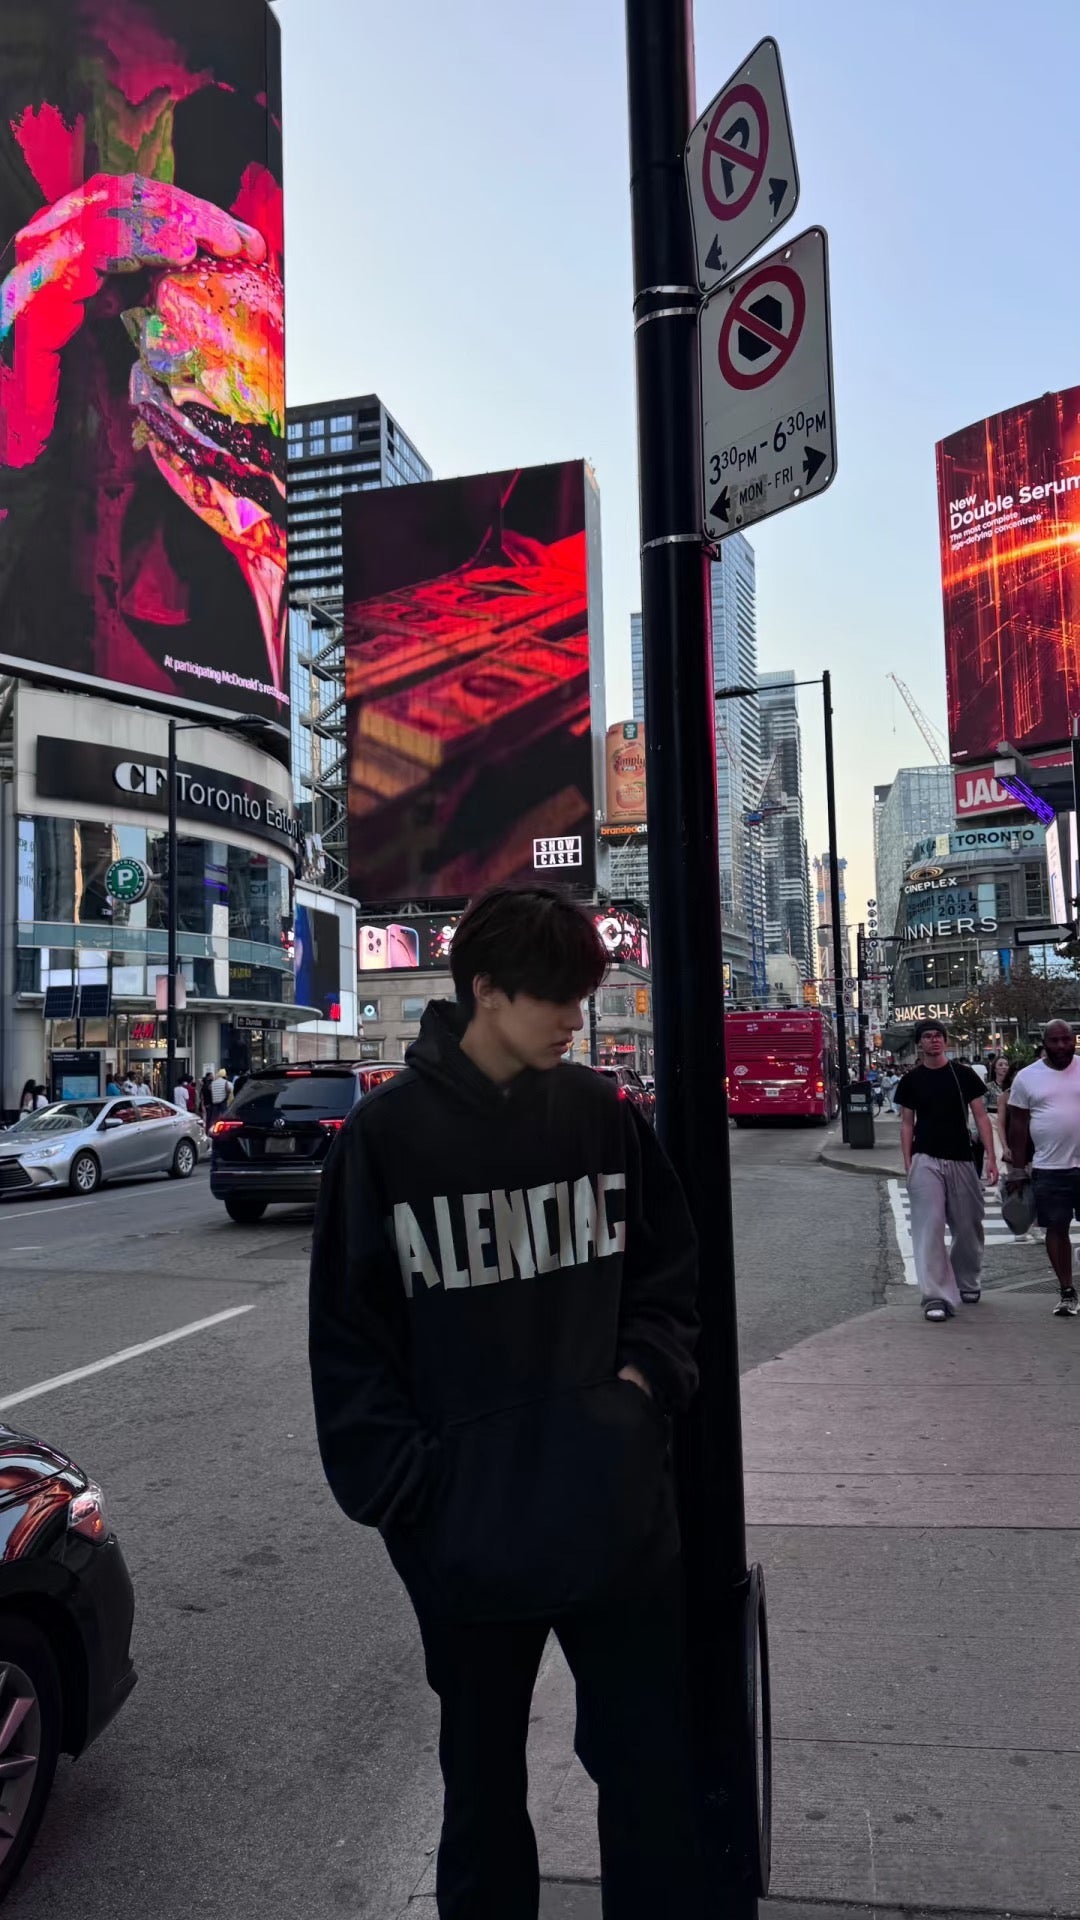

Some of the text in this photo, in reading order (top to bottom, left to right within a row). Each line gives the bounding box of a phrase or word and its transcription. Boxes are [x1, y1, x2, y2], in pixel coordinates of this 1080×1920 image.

[949, 494, 977, 514] New
[950, 476, 1080, 530] Double Serum
[949, 512, 1019, 543] The most complete
[164, 655, 174, 668] At
[174, 660, 222, 684] participating
[221, 670, 263, 692] McDonald's
[114, 762, 168, 795] CF
[175, 772, 261, 820] Toronto
[266, 799, 298, 838] Eaton
[958, 777, 1014, 808] JAC
[540, 839, 575, 852] SHOW
[955, 829, 1034, 847] TORONTO
[540, 852, 574, 866] CASE
[904, 877, 957, 894] CINEPLEX
[937, 891, 978, 905] FALL
[938, 903, 978, 917] 2024
[895, 1004, 927, 1022] SHAKE
